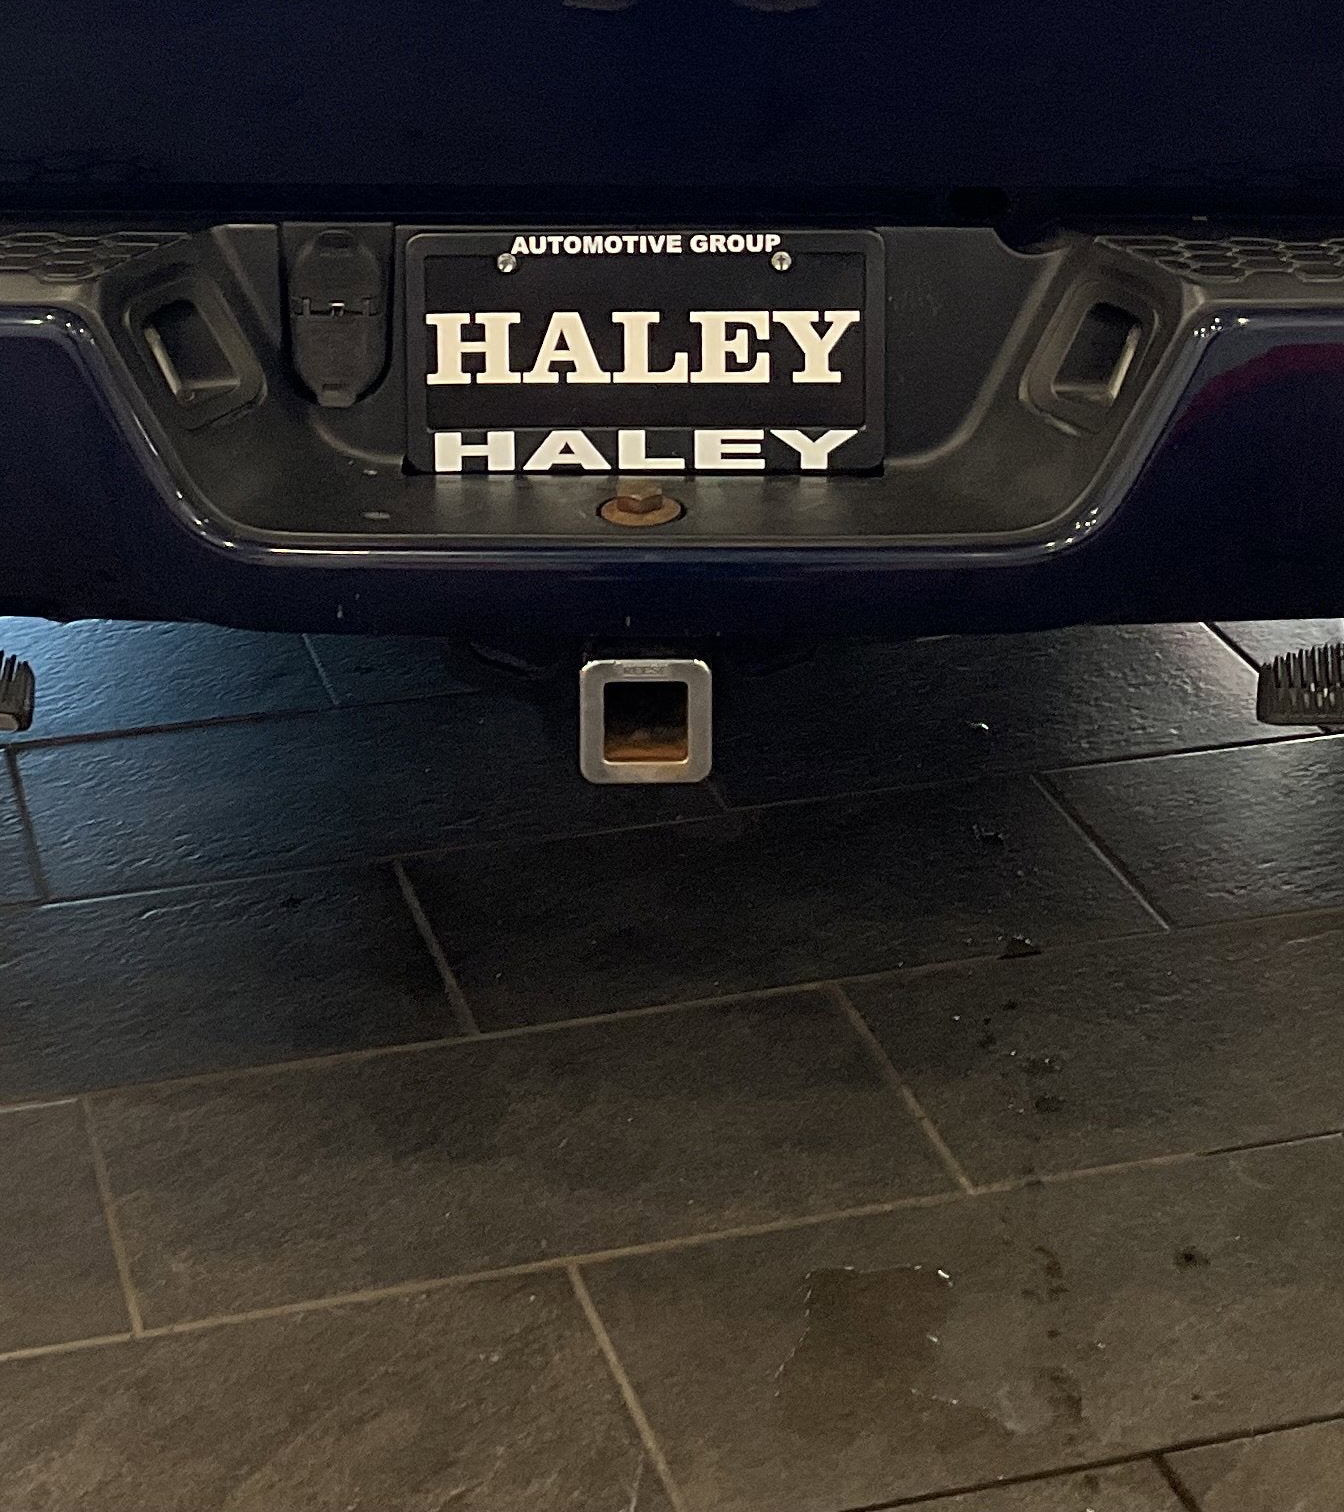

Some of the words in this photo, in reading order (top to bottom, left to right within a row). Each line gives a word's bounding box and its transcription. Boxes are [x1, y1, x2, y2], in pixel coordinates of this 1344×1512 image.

[510, 235, 683, 256] AUTOMOTIVE
[689, 233, 782, 254] GROUP
[425, 309, 861, 386] HALEY
[433, 428, 859, 472] HALEY
